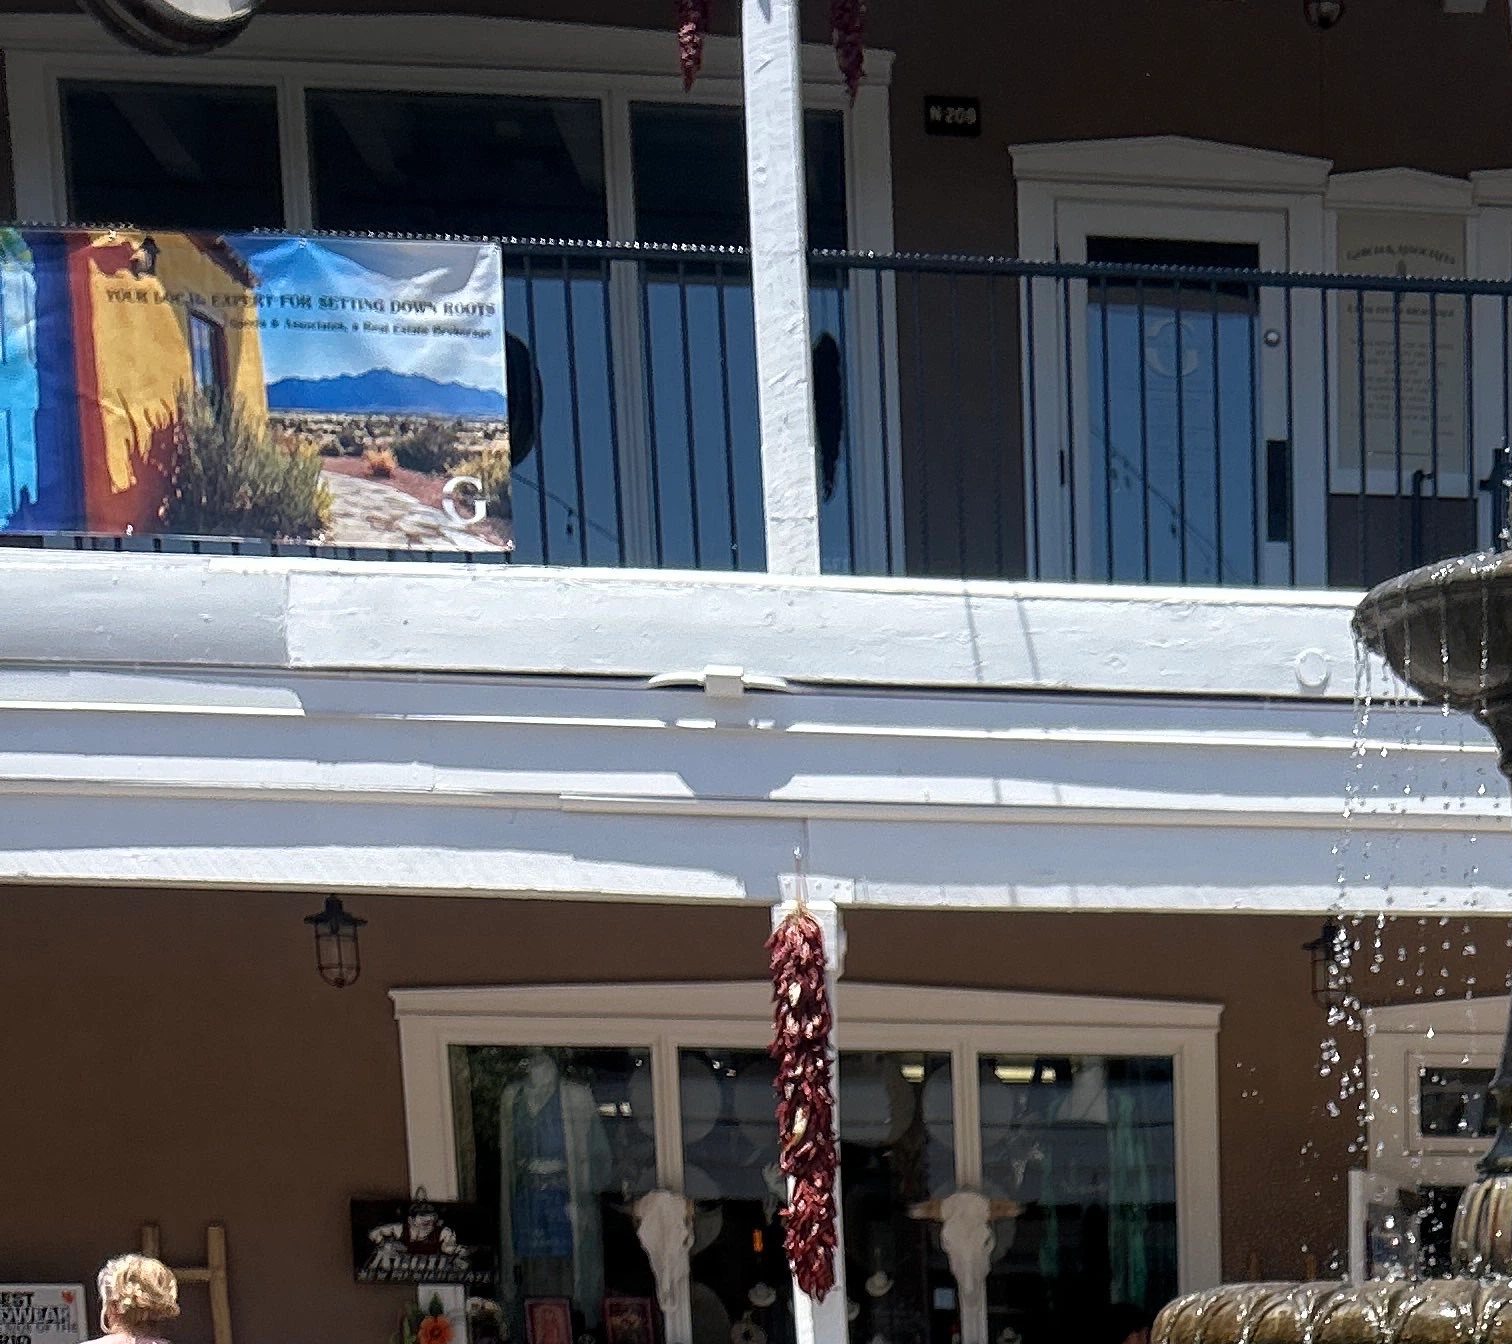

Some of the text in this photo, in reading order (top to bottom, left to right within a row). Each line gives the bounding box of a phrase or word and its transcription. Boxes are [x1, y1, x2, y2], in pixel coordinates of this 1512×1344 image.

[107, 288, 148, 303] YOUR
[211, 293, 272, 309] EXPERT
[280, 294, 312, 309] FOR
[318, 295, 385, 313] SETTING
[390, 300, 437, 315] DOWN
[443, 302, 496, 317] ROOTS
